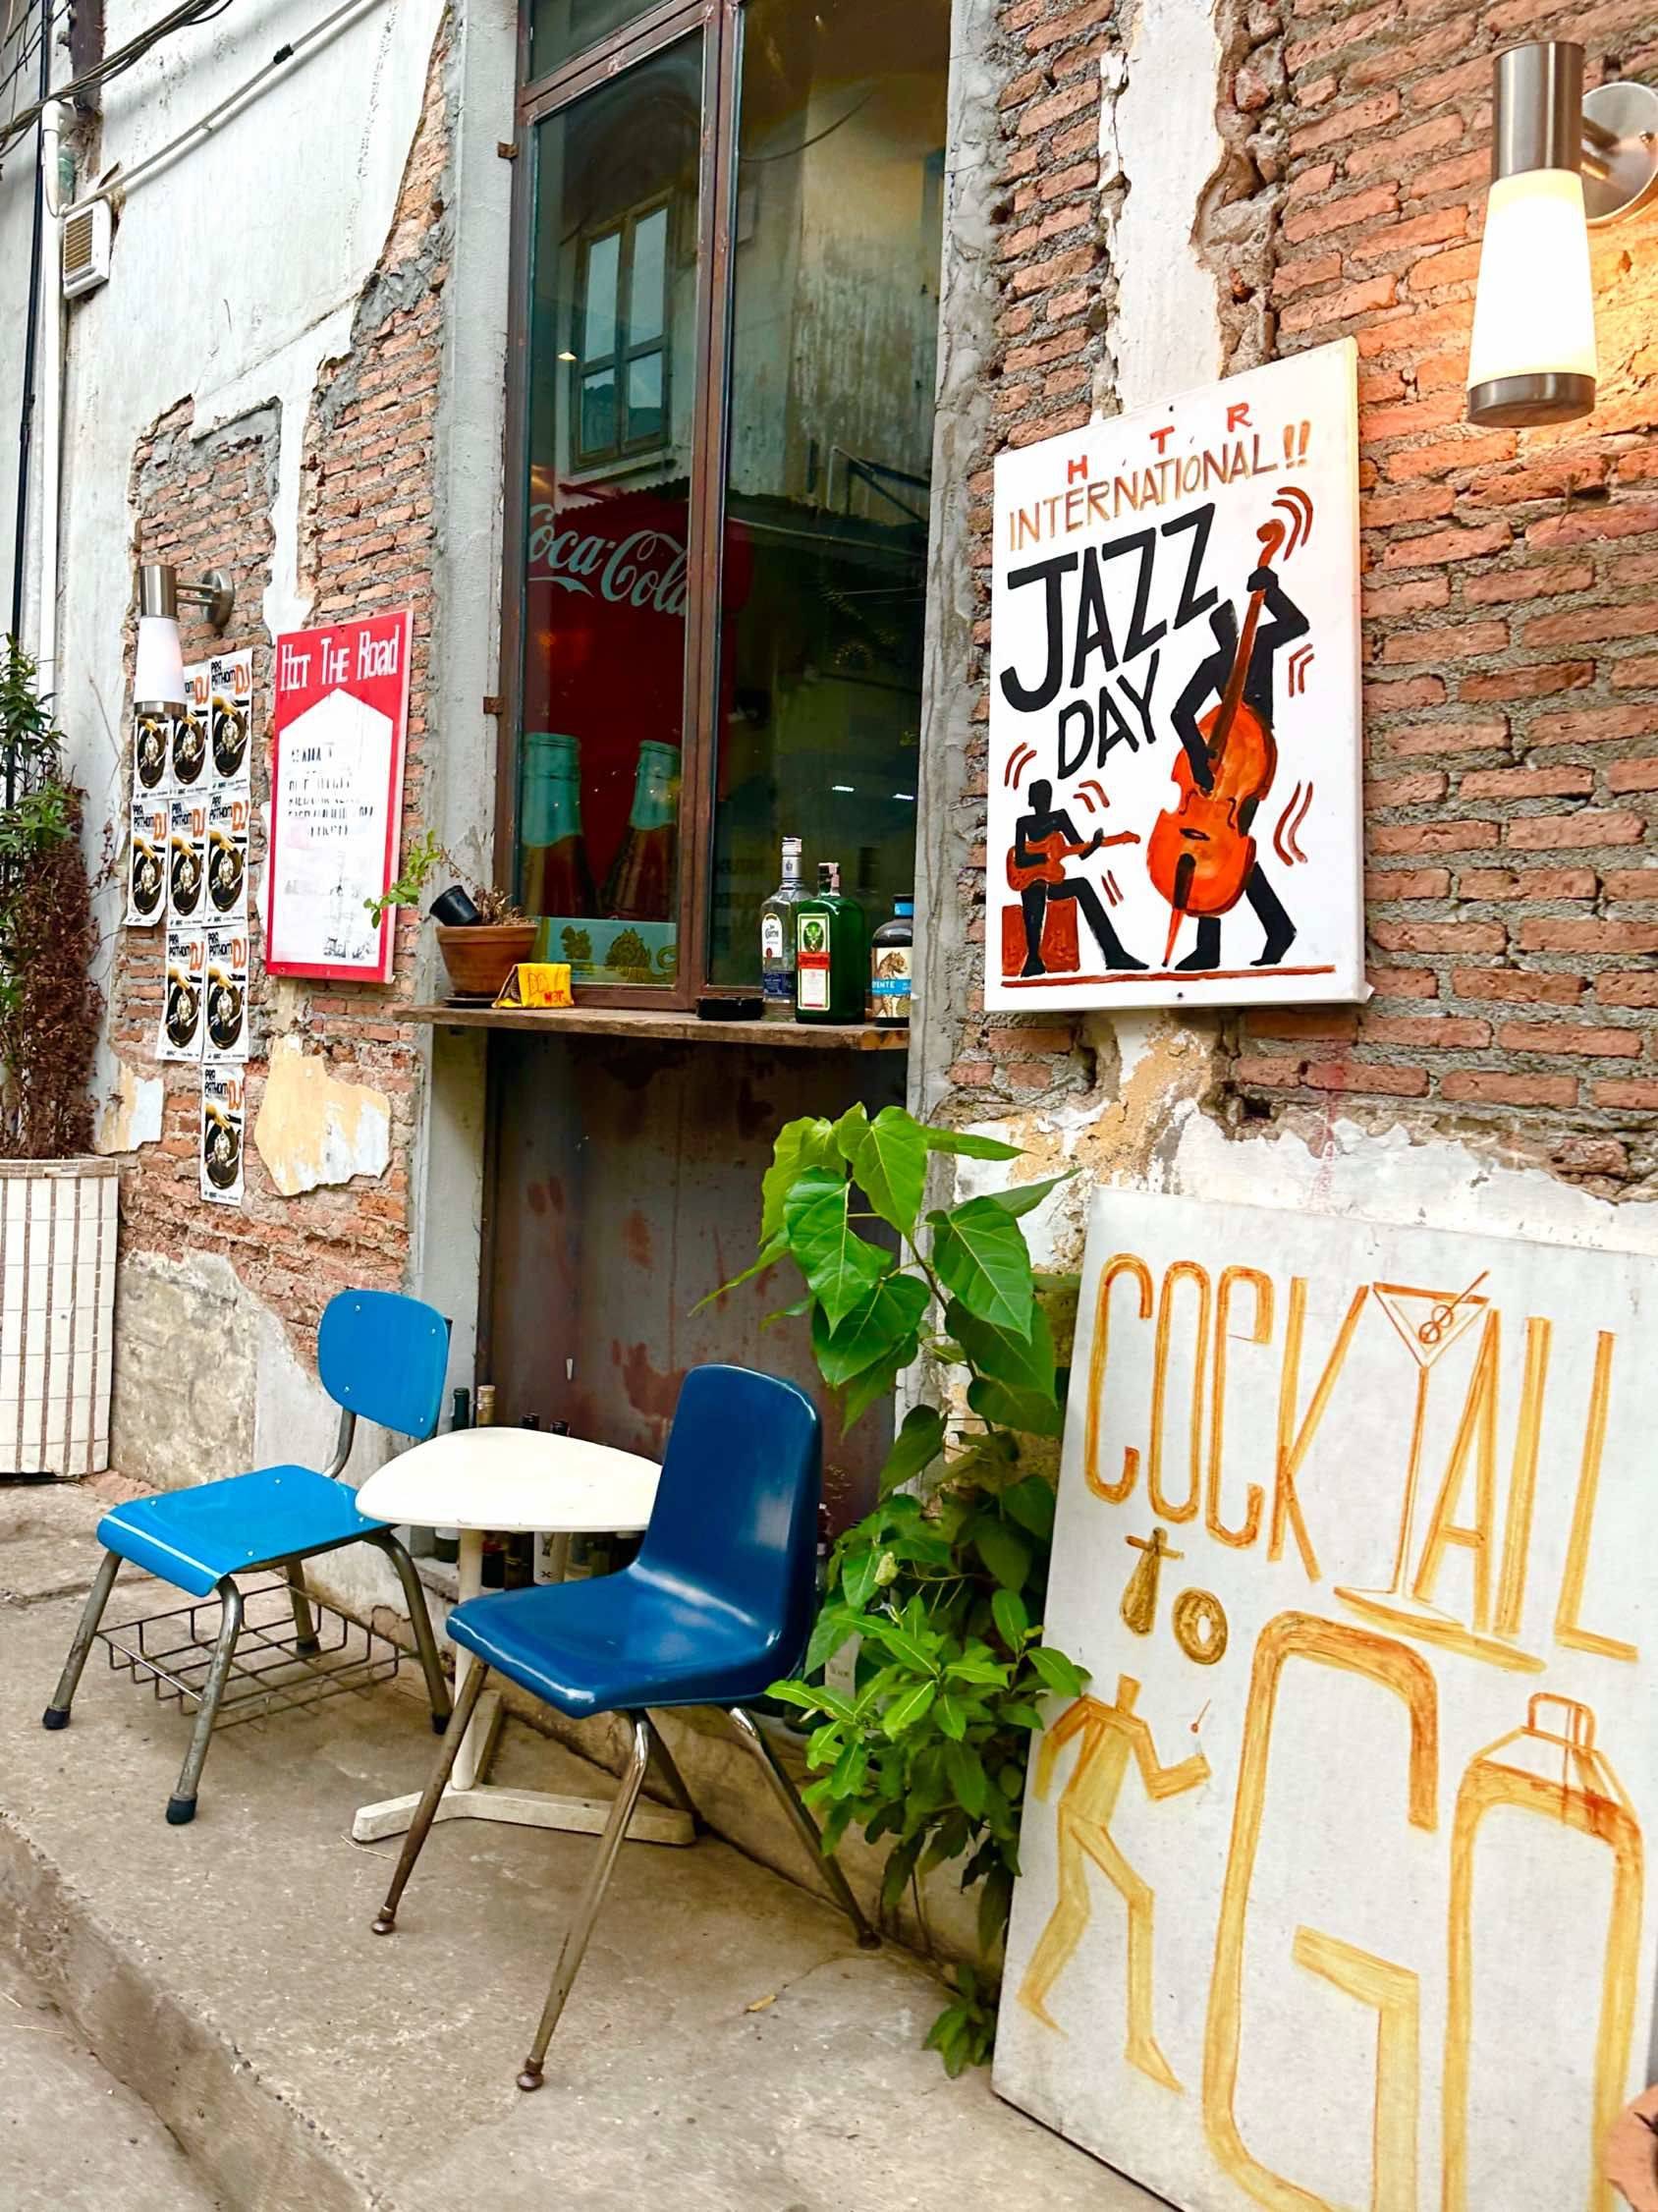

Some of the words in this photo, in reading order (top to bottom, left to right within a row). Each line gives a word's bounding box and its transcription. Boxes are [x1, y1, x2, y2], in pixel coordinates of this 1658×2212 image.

[1067, 455, 1088, 484] H
[1149, 425, 1176, 454] T
[1226, 402, 1253, 432] R
[999, 502, 1219, 712] JAZZ
[356, 624, 401, 681] Road
[194, 675, 209, 706] DJ
[236, 662, 250, 695] DJ
[1057, 648, 1160, 780] DAY
[153, 812, 167, 841] DJ
[192, 806, 206, 838] DJ
[232, 799, 249, 831] DJ
[190, 941, 204, 970] DJ
[232, 938, 247, 969] DJ
[227, 1079, 244, 1111] DJ
[1083, 1252, 1641, 1673] COCKTAIL
